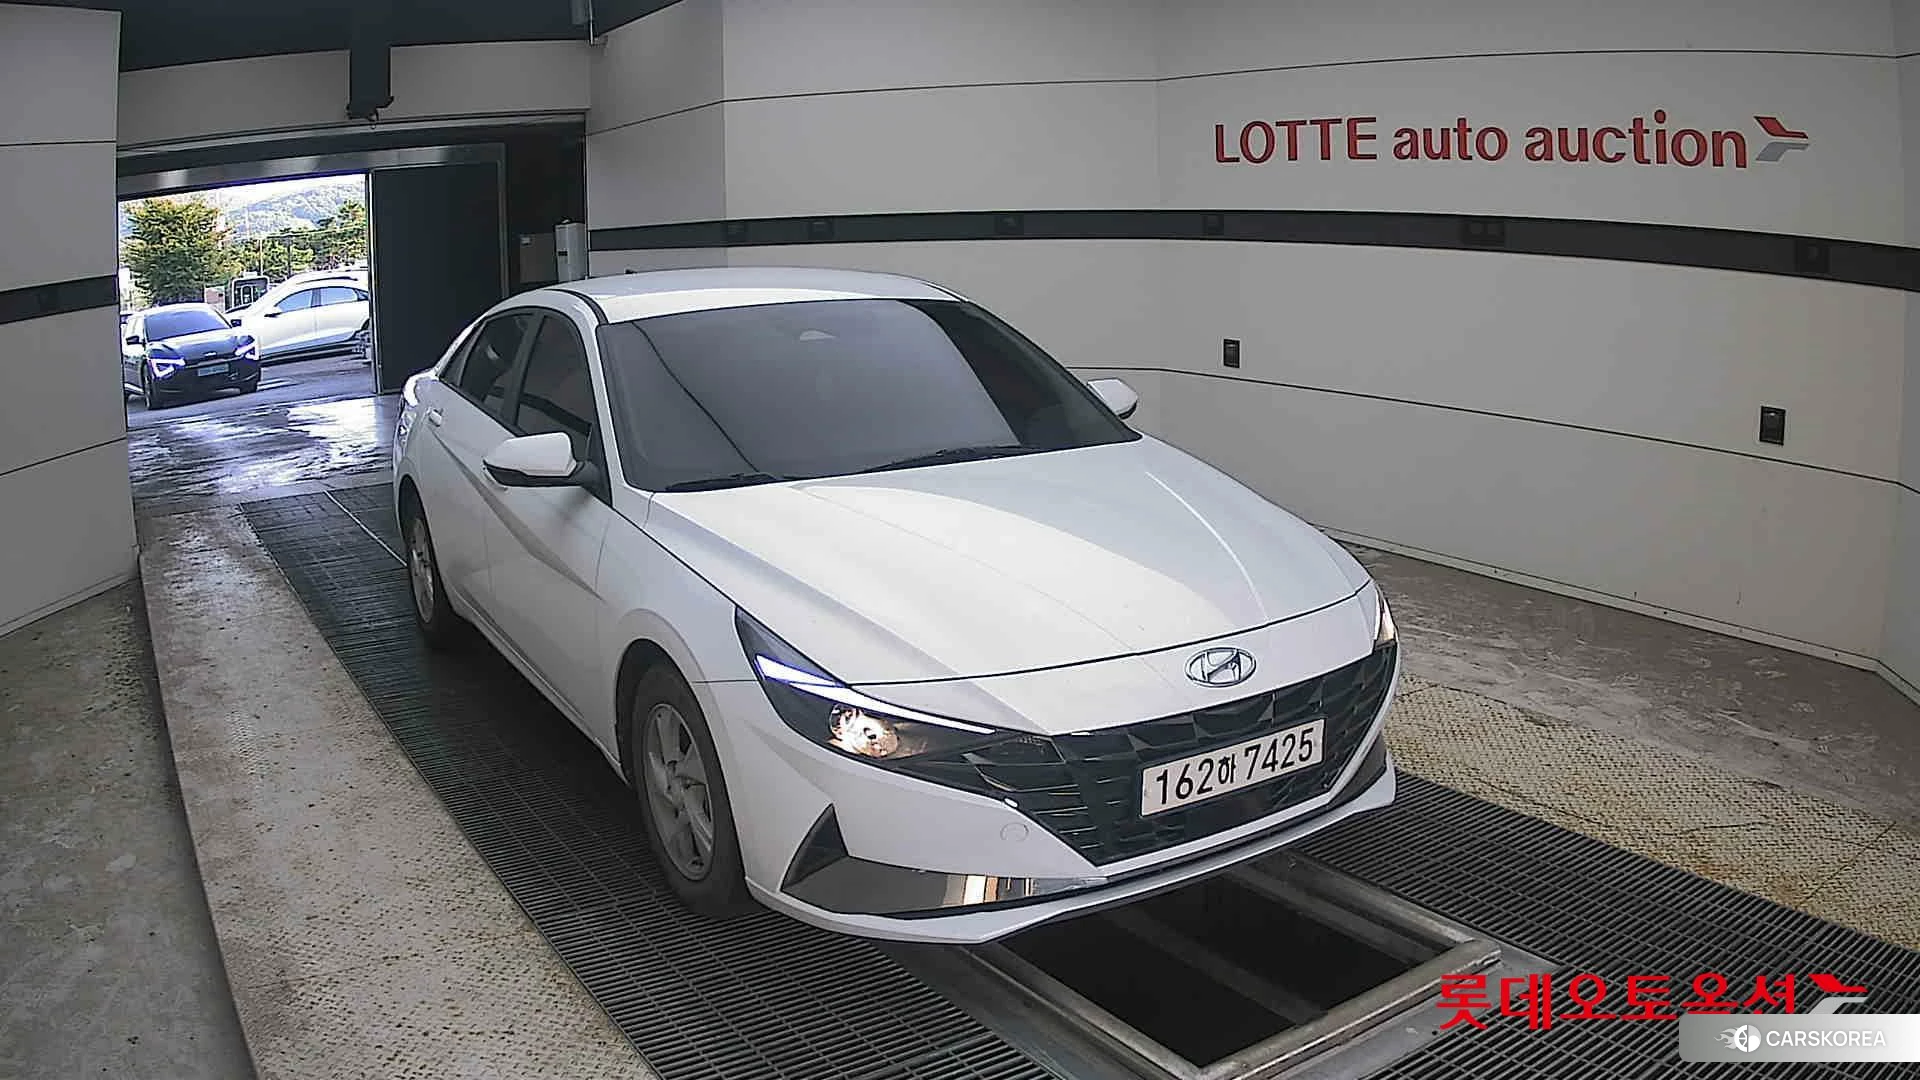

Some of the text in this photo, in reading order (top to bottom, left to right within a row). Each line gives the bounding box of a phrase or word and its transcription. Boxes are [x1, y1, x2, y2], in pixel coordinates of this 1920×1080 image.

[1215, 110, 1748, 168] LOTTE auto auction
[1156, 728, 1314, 804] 162하 7425
